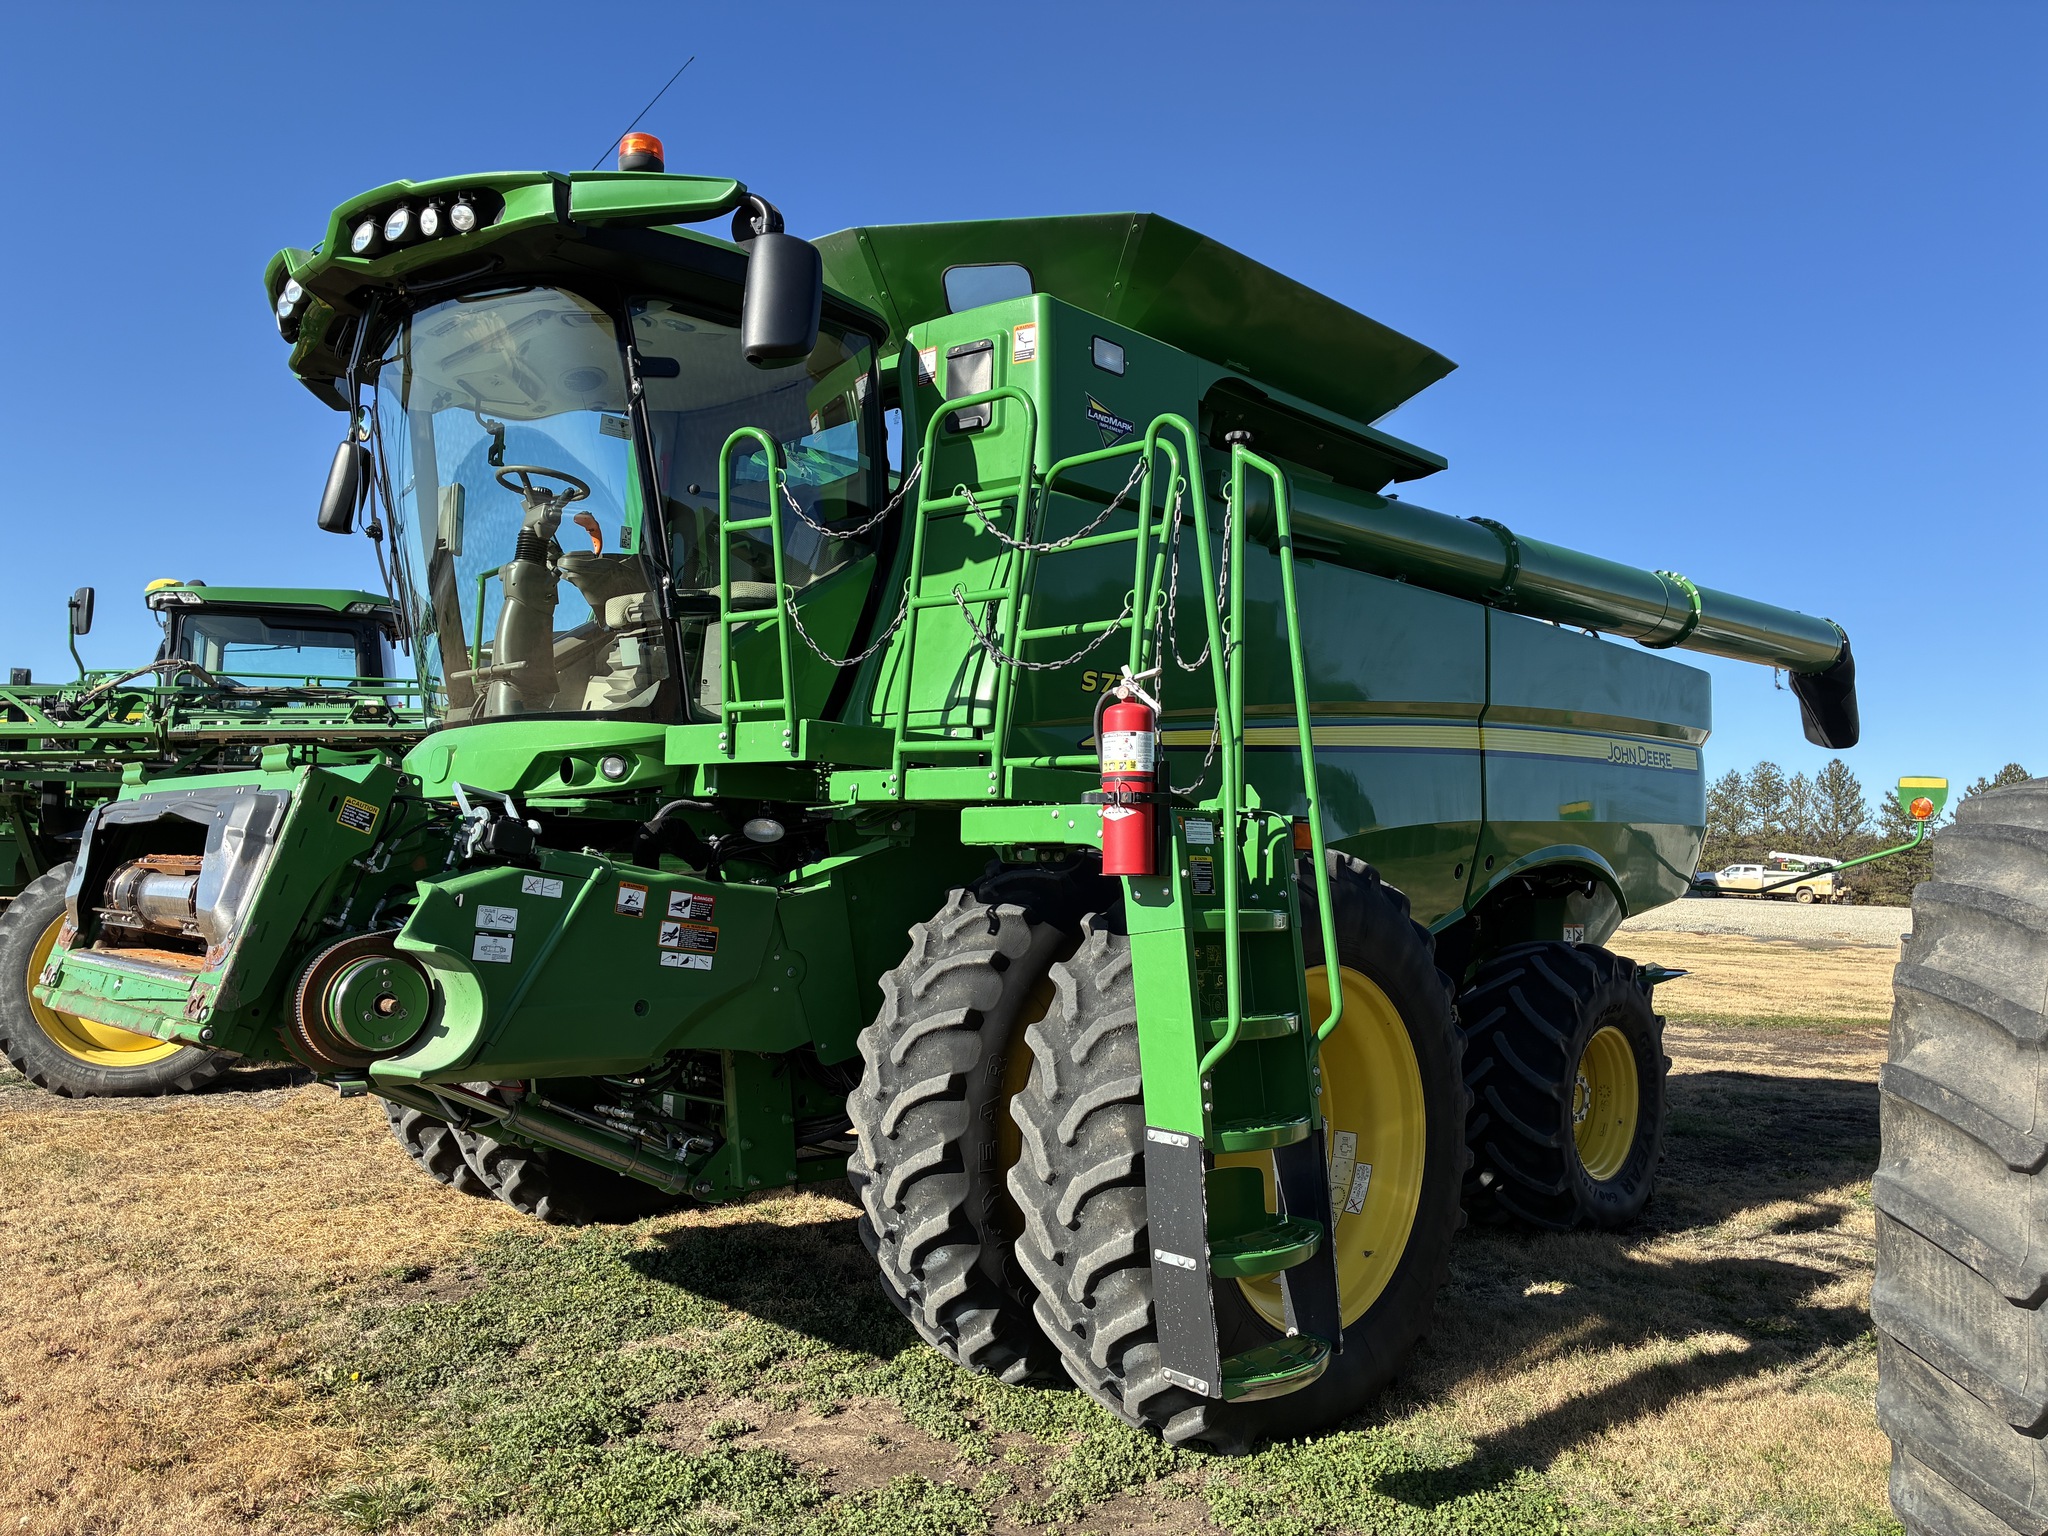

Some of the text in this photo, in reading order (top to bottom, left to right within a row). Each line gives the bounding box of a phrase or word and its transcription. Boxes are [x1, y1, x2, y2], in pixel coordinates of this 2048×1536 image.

[1607, 742, 1673, 768] JOHN DEERE
[351, 799, 378, 814] CAUTION
